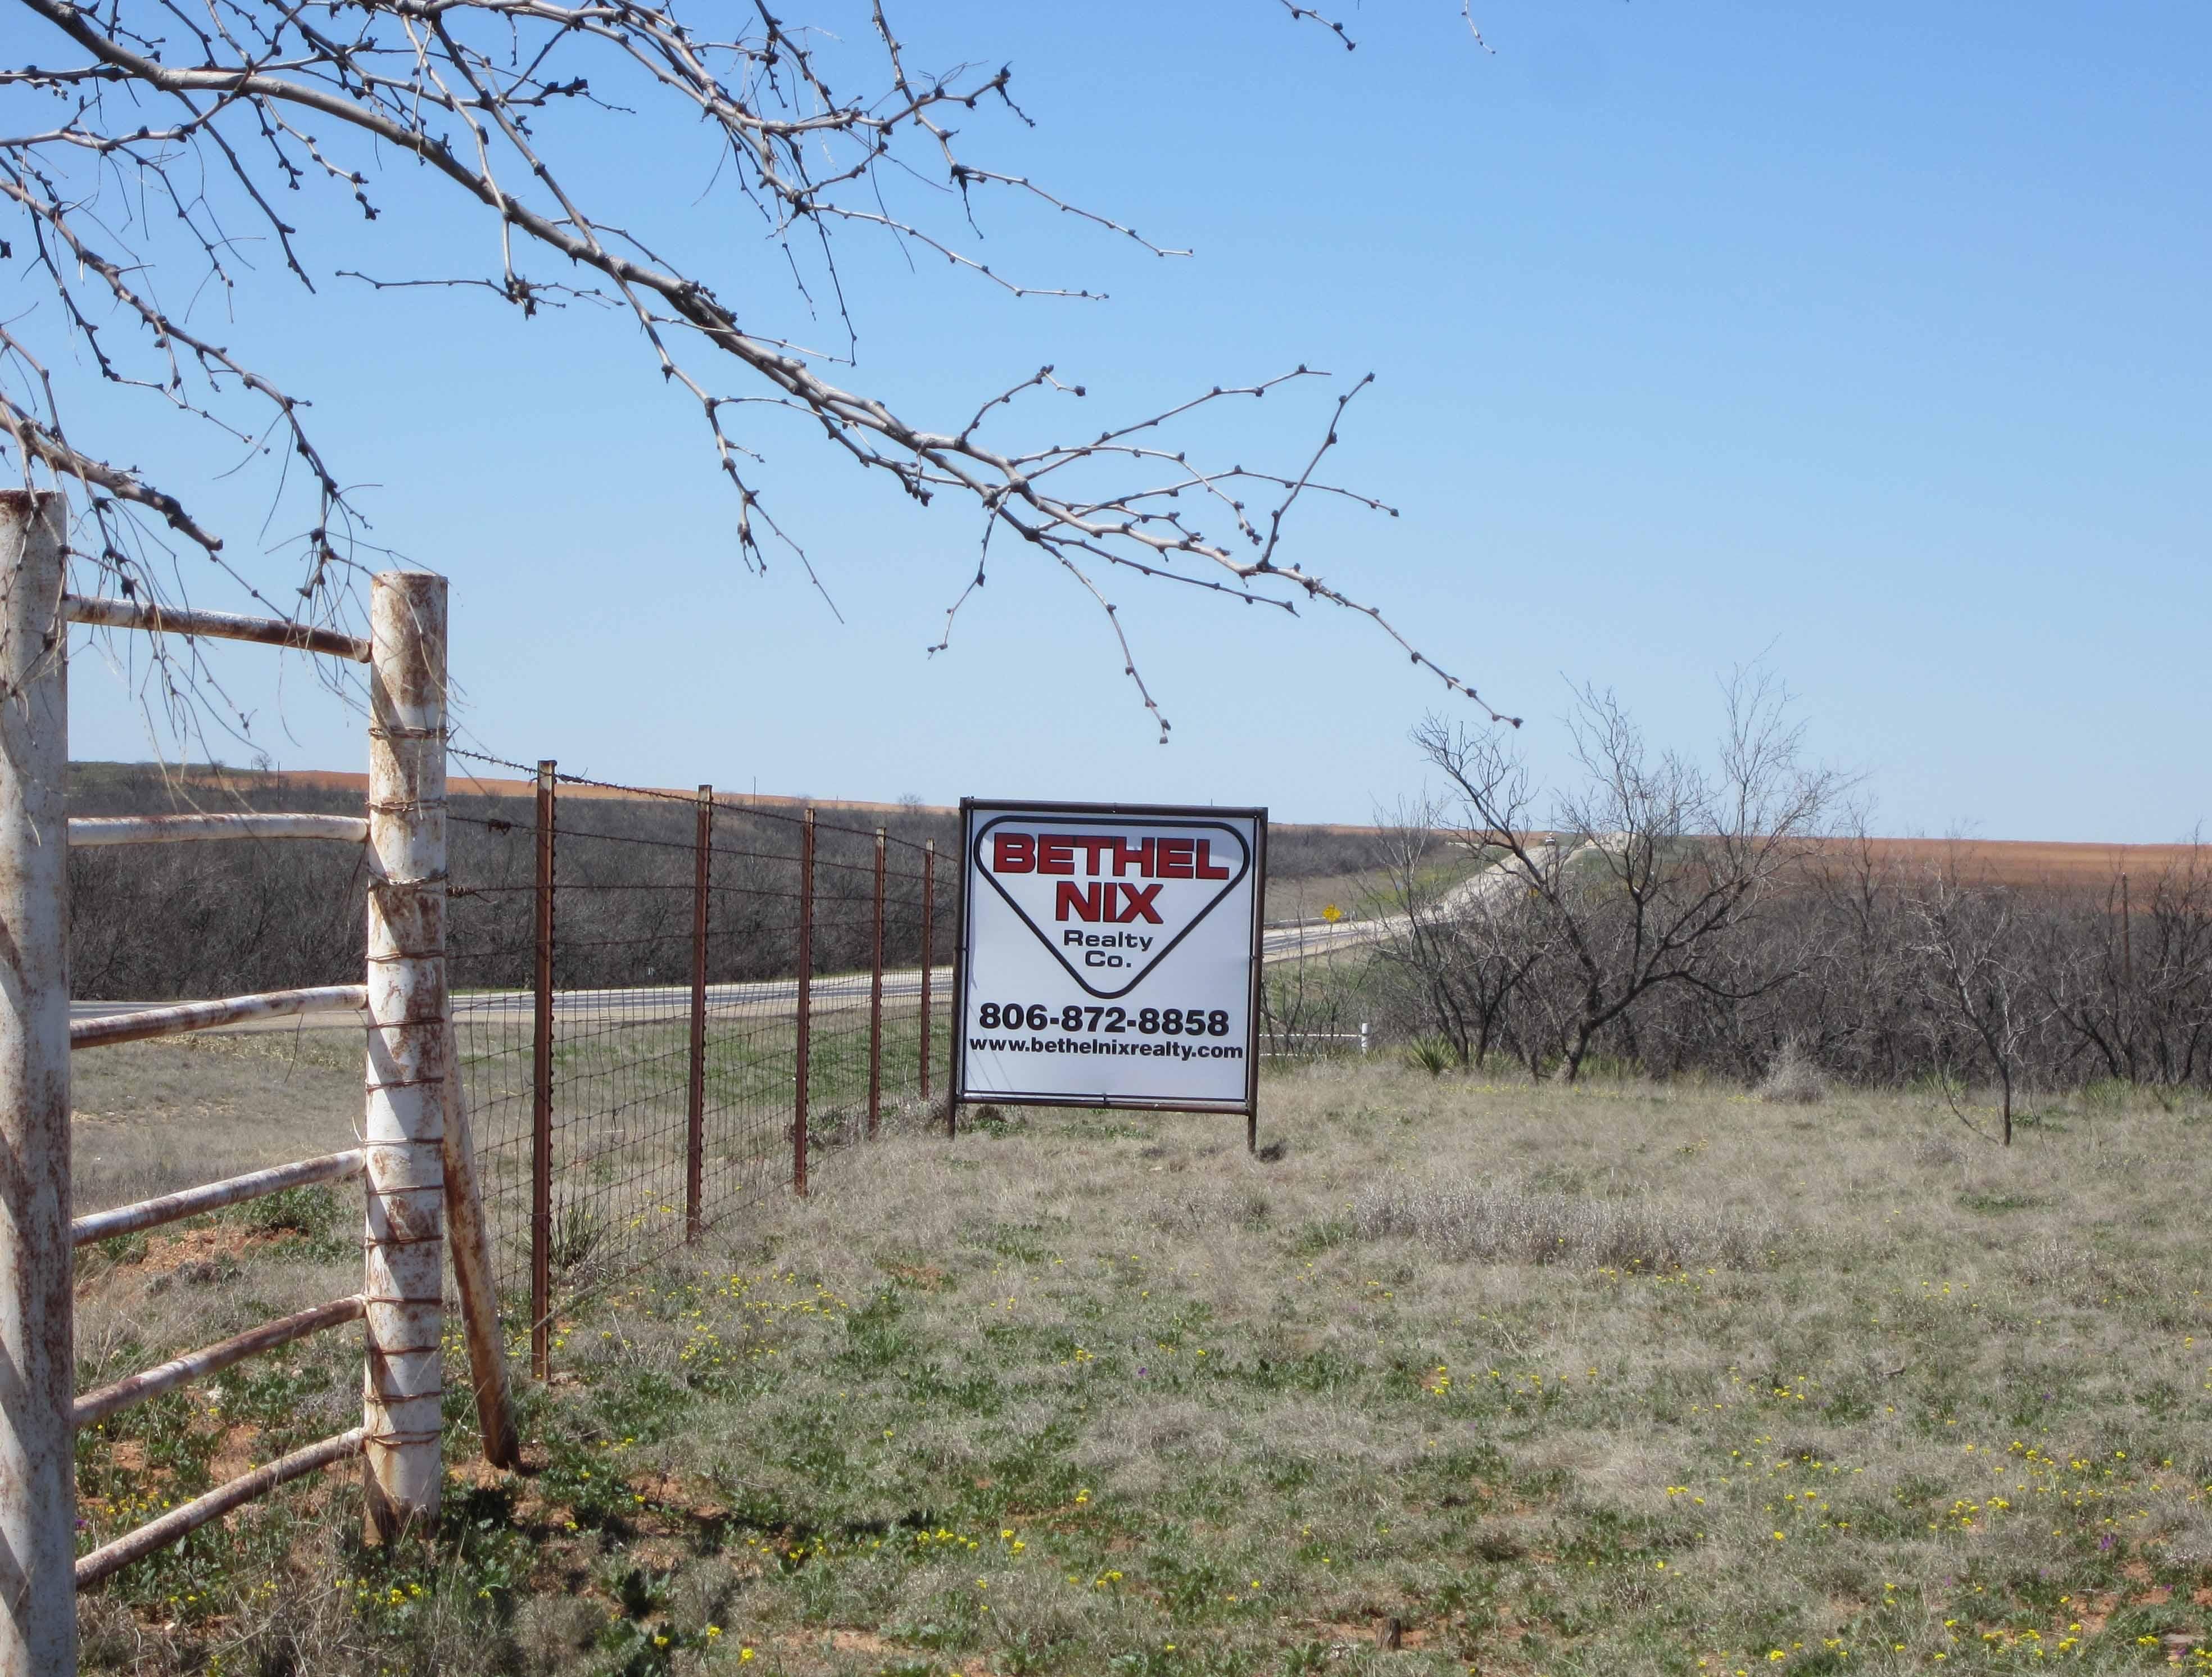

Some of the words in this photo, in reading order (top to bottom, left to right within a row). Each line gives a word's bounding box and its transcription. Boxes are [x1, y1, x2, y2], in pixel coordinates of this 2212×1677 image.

[993, 832, 1230, 880] BETHEL
[1056, 881, 1164, 924] NIX
[1064, 930, 1154, 951] Realty
[1085, 951, 1132, 968] Co.
[979, 1003, 1230, 1036] 806-872-8858
[969, 1037, 1243, 1061] www.bethelnixrealty.com
